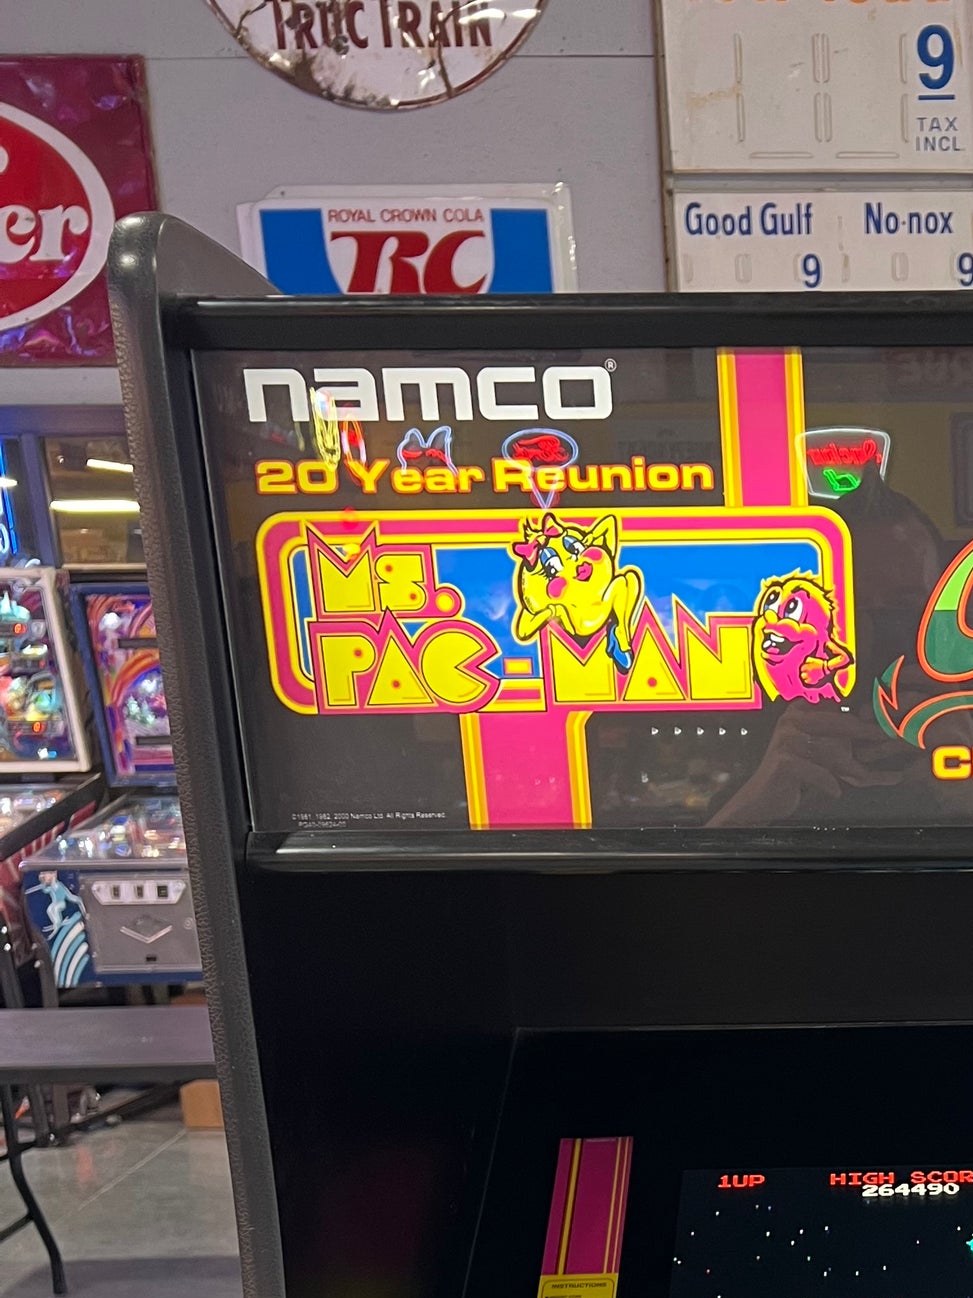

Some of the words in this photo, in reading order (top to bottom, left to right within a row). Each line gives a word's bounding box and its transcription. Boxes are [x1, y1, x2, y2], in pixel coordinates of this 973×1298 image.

[917, 25, 955, 89] 9
[916, 116, 959, 132] TAX
[328, 208, 375, 223] ROYAL
[380, 208, 437, 222] CROWN
[443, 208, 485, 222] COLA
[685, 202, 752, 236] Good
[760, 202, 813, 235] Gulf
[330, 230, 488, 294] RC
[802, 253, 822, 288] 9
[243, 366, 613, 422] namco
[255, 459, 339, 494] 20
[348, 458, 485, 494] Year
[491, 455, 714, 493] Reunion
[717, 1174, 765, 1189] 1UP
[830, 1172, 895, 1187] HIGH
[861, 1182, 960, 1198] 264490
